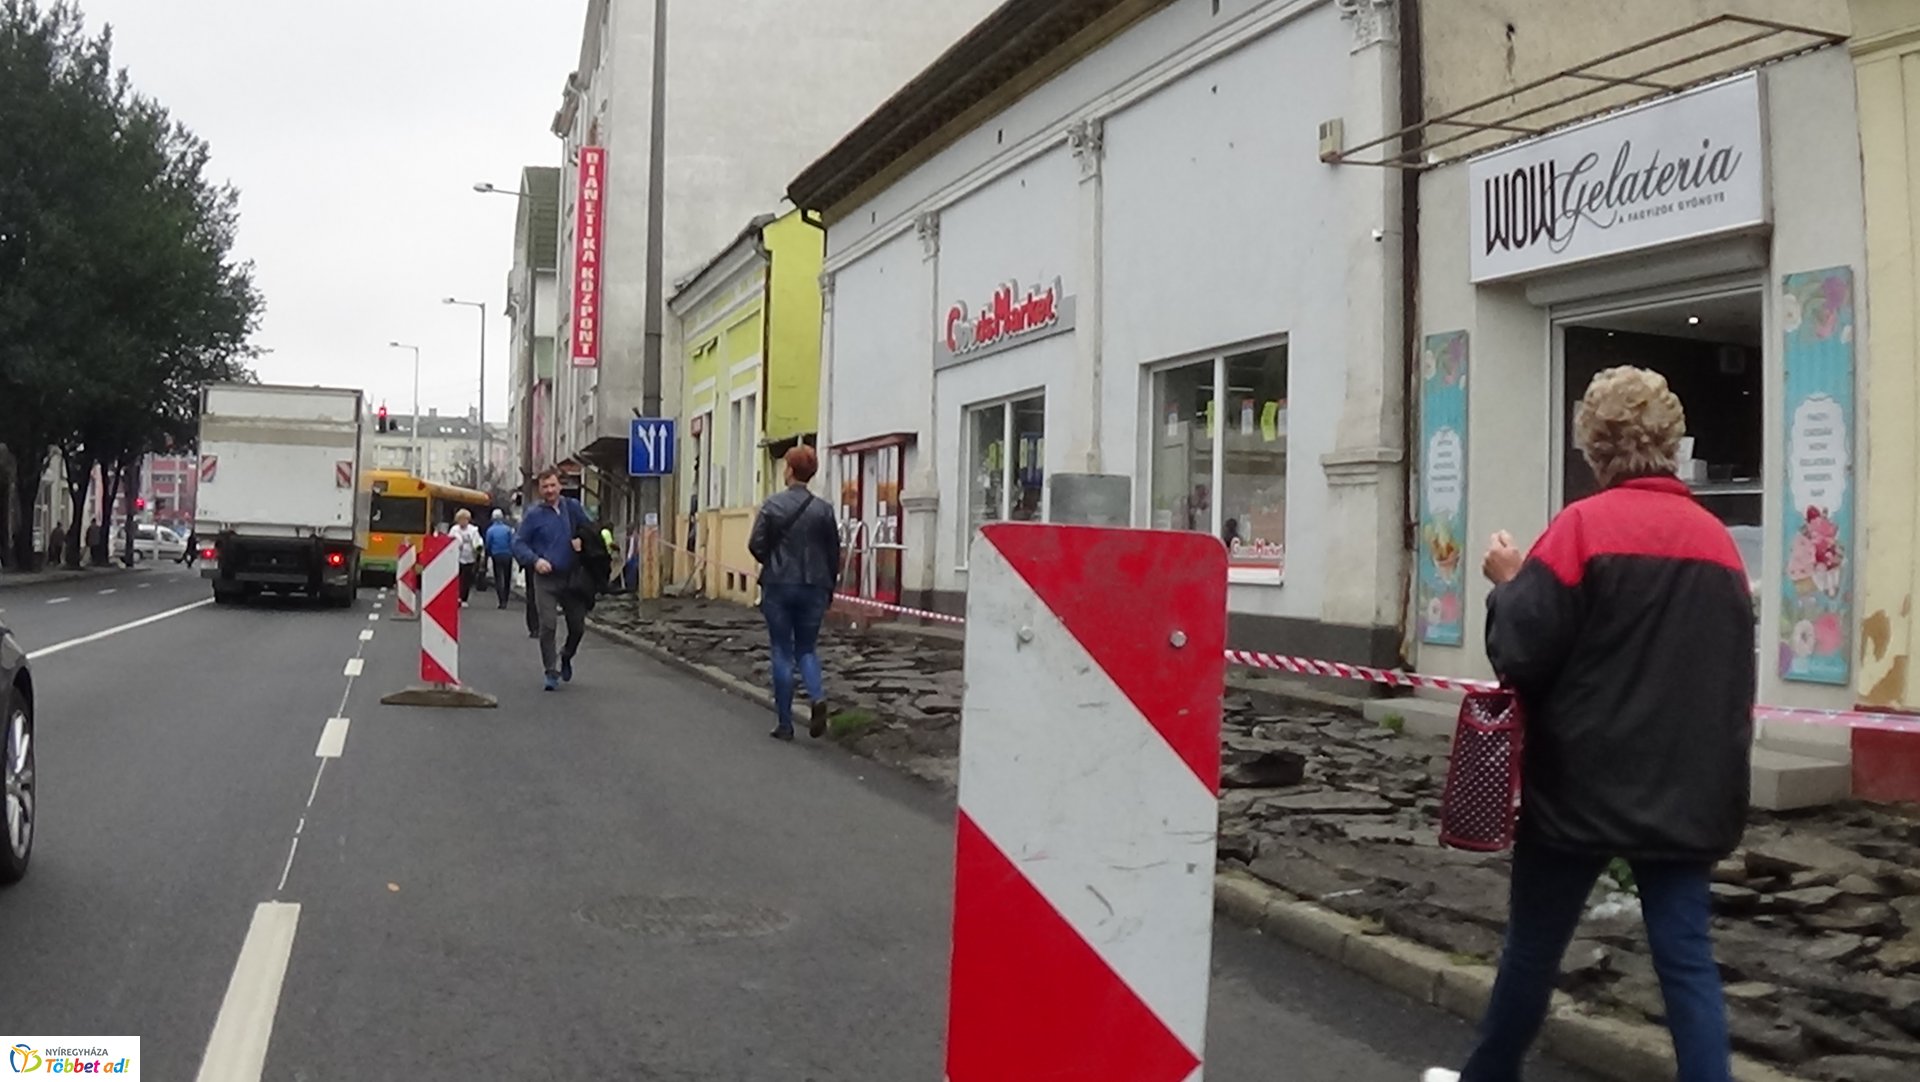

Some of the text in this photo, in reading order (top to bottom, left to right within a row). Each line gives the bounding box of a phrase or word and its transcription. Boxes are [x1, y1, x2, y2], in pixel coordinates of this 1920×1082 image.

[582, 152, 600, 262] DIANETIKA
[1485, 139, 1742, 257] WOW Gelateria
